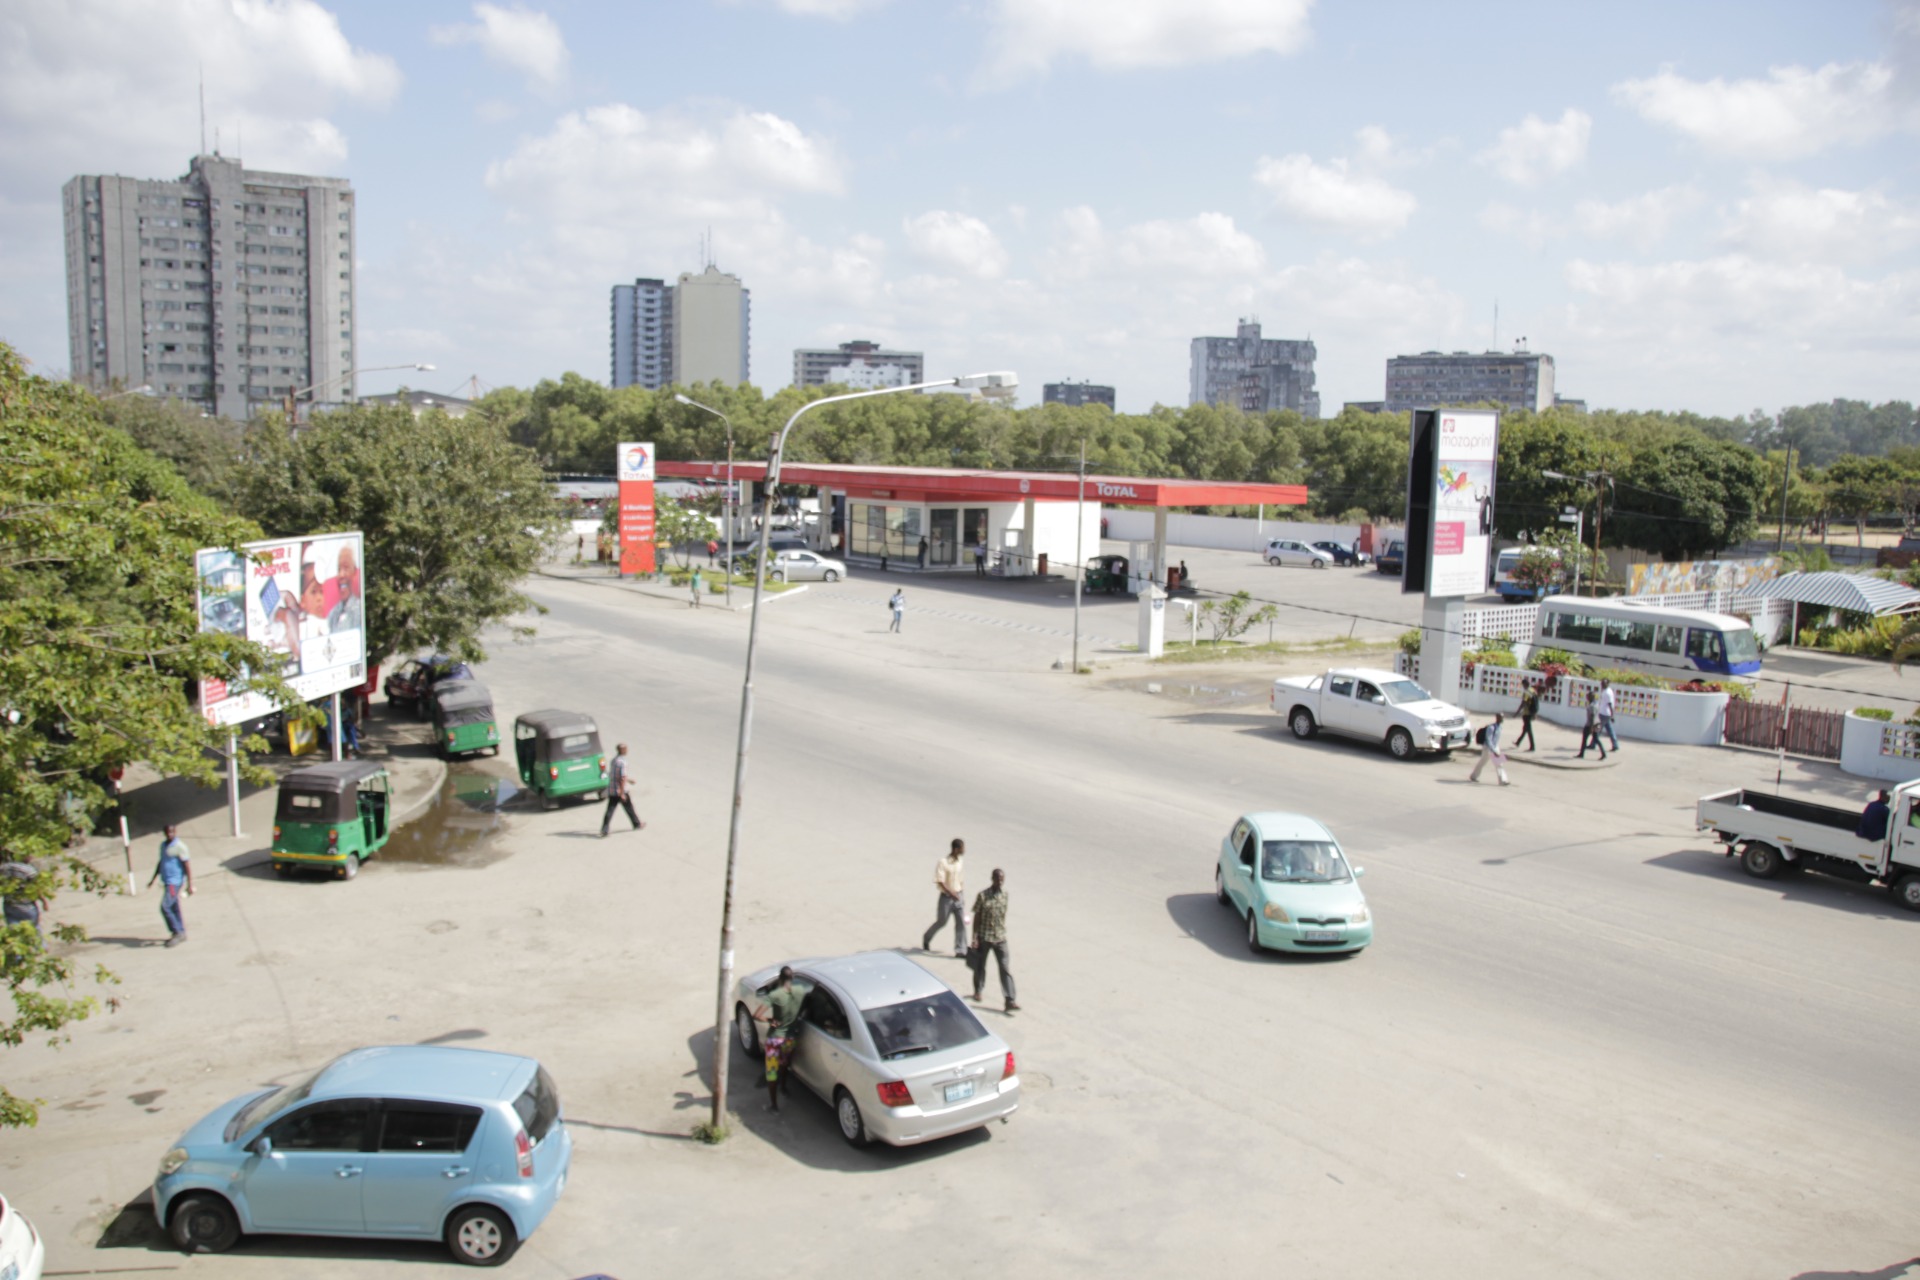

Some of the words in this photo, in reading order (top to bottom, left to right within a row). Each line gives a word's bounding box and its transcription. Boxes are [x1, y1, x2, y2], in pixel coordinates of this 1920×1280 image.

[1441, 434, 1493, 451] mozaprint
[623, 472, 651, 480] TOTAL
[1096, 482, 1138, 498] TOTAL
